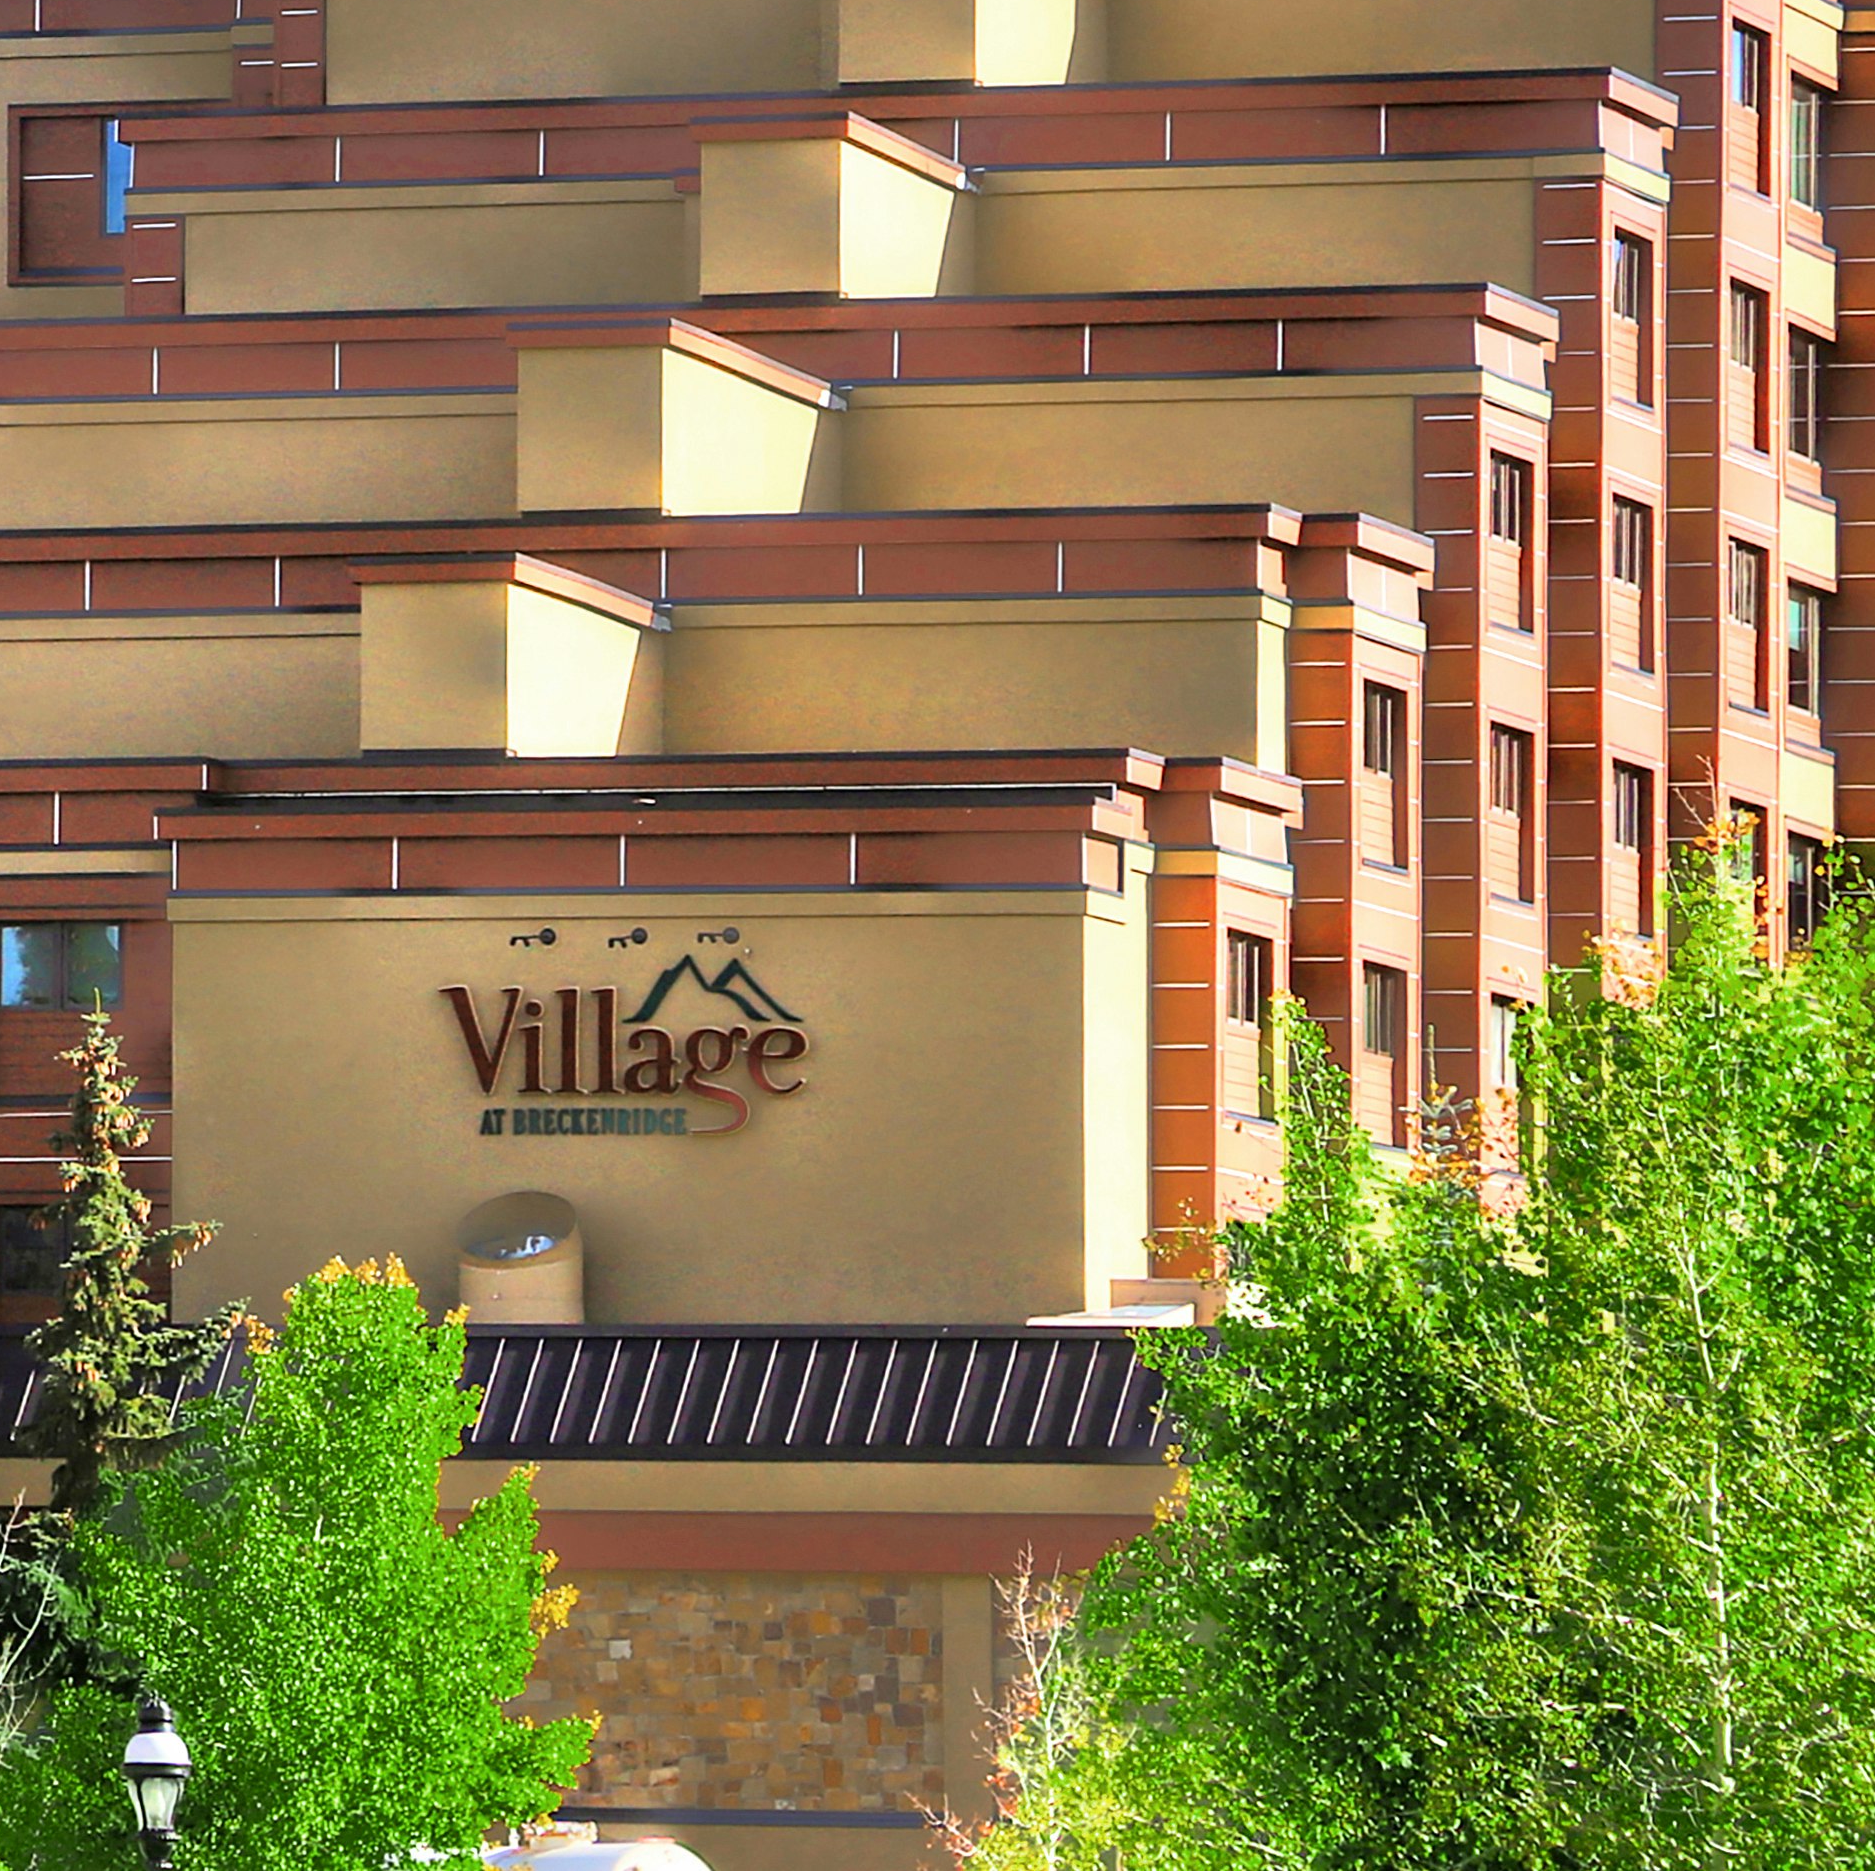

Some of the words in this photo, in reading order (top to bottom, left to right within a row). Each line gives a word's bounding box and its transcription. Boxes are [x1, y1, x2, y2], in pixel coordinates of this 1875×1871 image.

[438, 985, 809, 1136] Village
[480, 1108, 506, 1135] AT
[513, 1108, 687, 1135] BRECKENRIDGE
